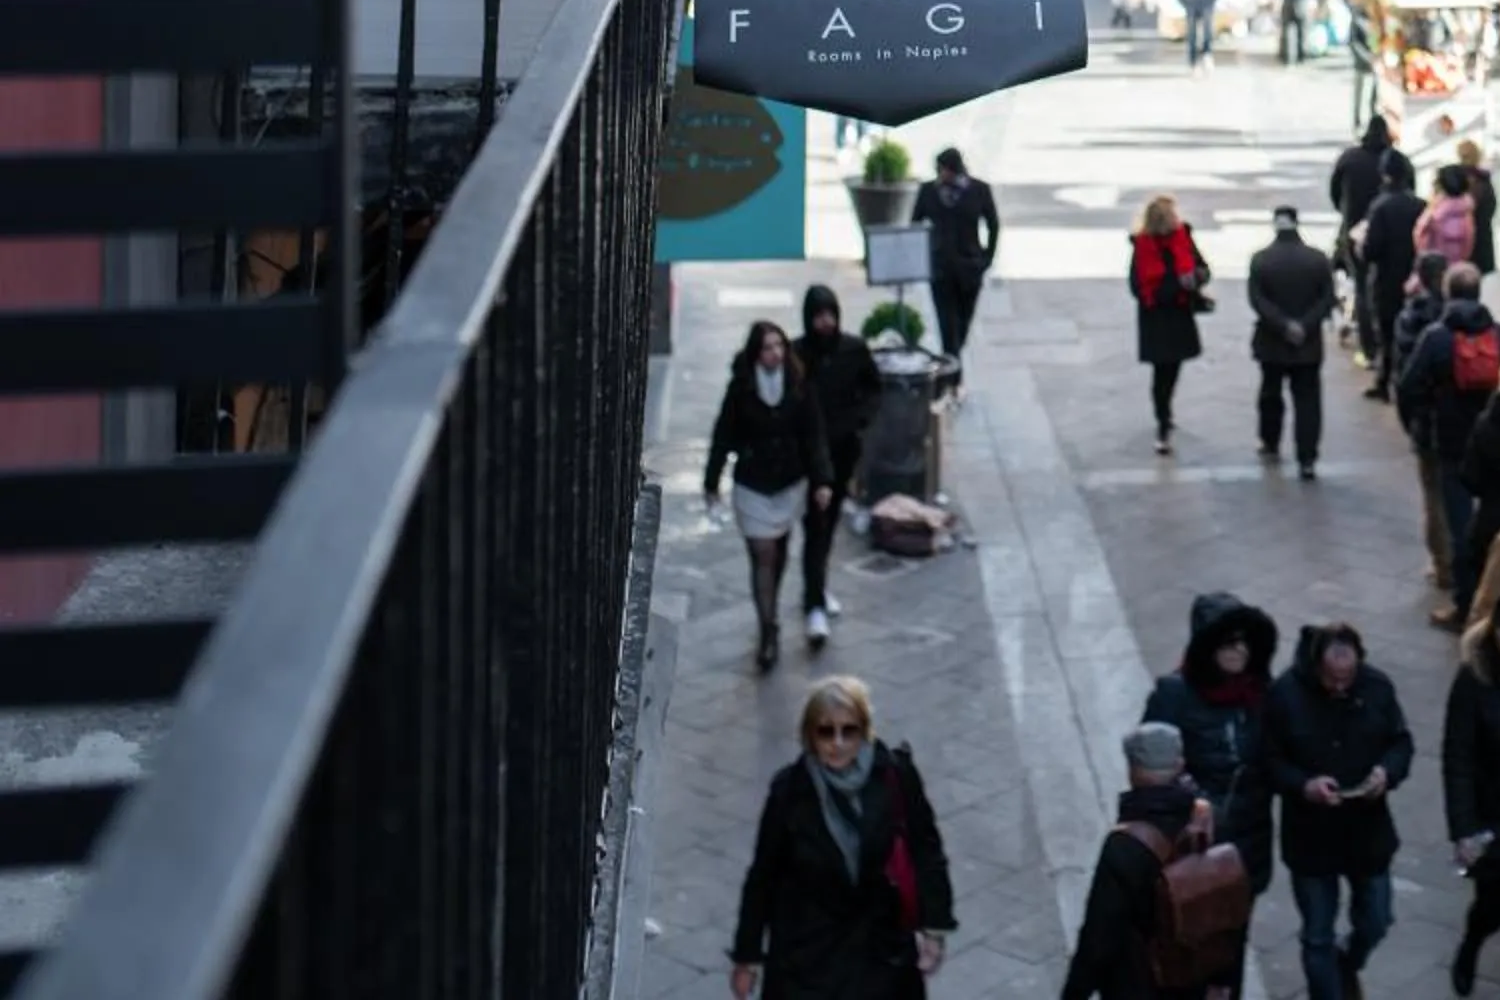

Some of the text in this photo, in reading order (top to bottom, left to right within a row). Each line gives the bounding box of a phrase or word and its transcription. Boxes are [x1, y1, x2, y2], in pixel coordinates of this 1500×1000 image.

[807, 43, 968, 62] Rooms in Naples
